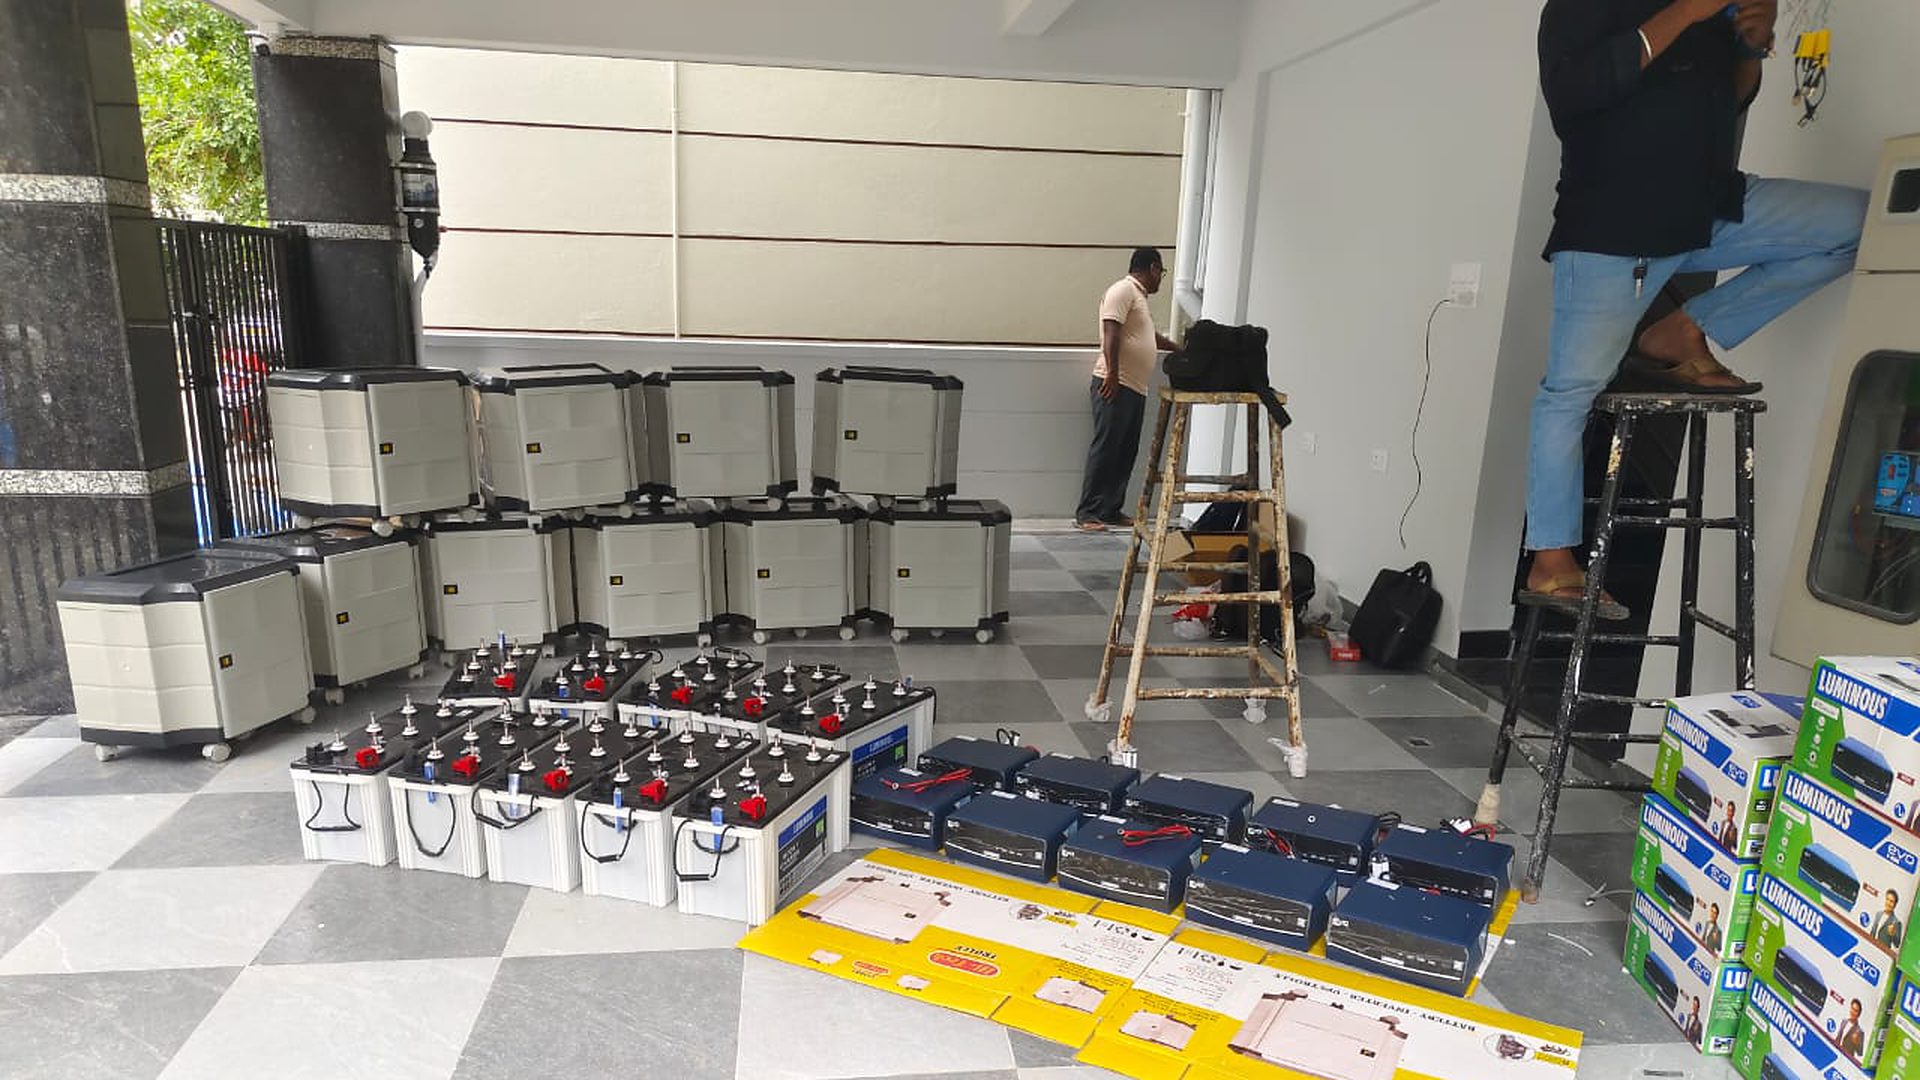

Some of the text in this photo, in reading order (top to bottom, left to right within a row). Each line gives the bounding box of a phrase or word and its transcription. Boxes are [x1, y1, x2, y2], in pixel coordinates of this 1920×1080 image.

[1818, 669, 1888, 720] LUMINOUS
[1667, 709, 1709, 754] LUMINOUS
[1785, 775, 1853, 830] LUMINOUS
[1643, 805, 1689, 853] LUMINOUS
[1635, 892, 1675, 943] LUMINOUS
[1761, 878, 1824, 936] LUMINOUS
[1752, 983, 1807, 1048] LUMINOUS
